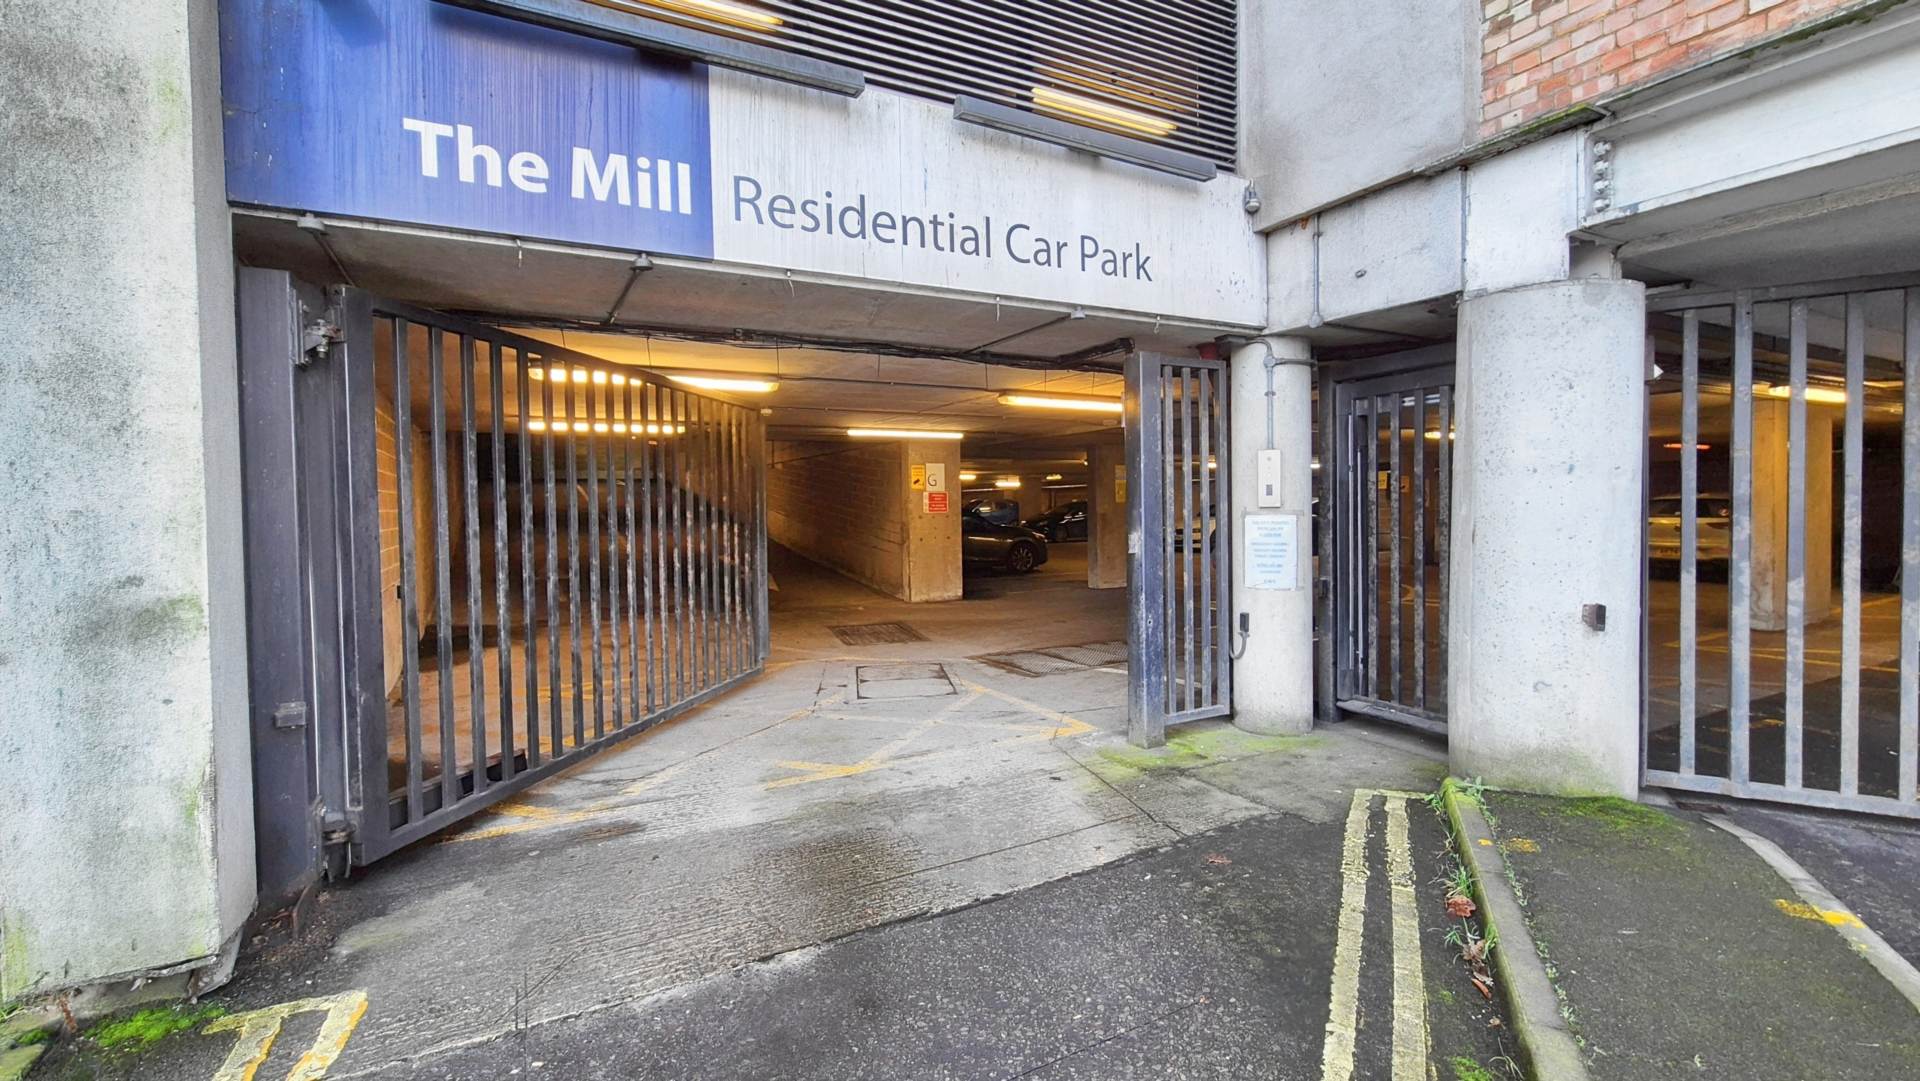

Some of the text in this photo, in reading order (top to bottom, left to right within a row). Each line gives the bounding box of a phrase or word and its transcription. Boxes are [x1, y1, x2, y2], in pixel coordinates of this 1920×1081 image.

[403, 118, 1153, 281] The Mill Residential Car Park
[927, 473, 937, 487] G
